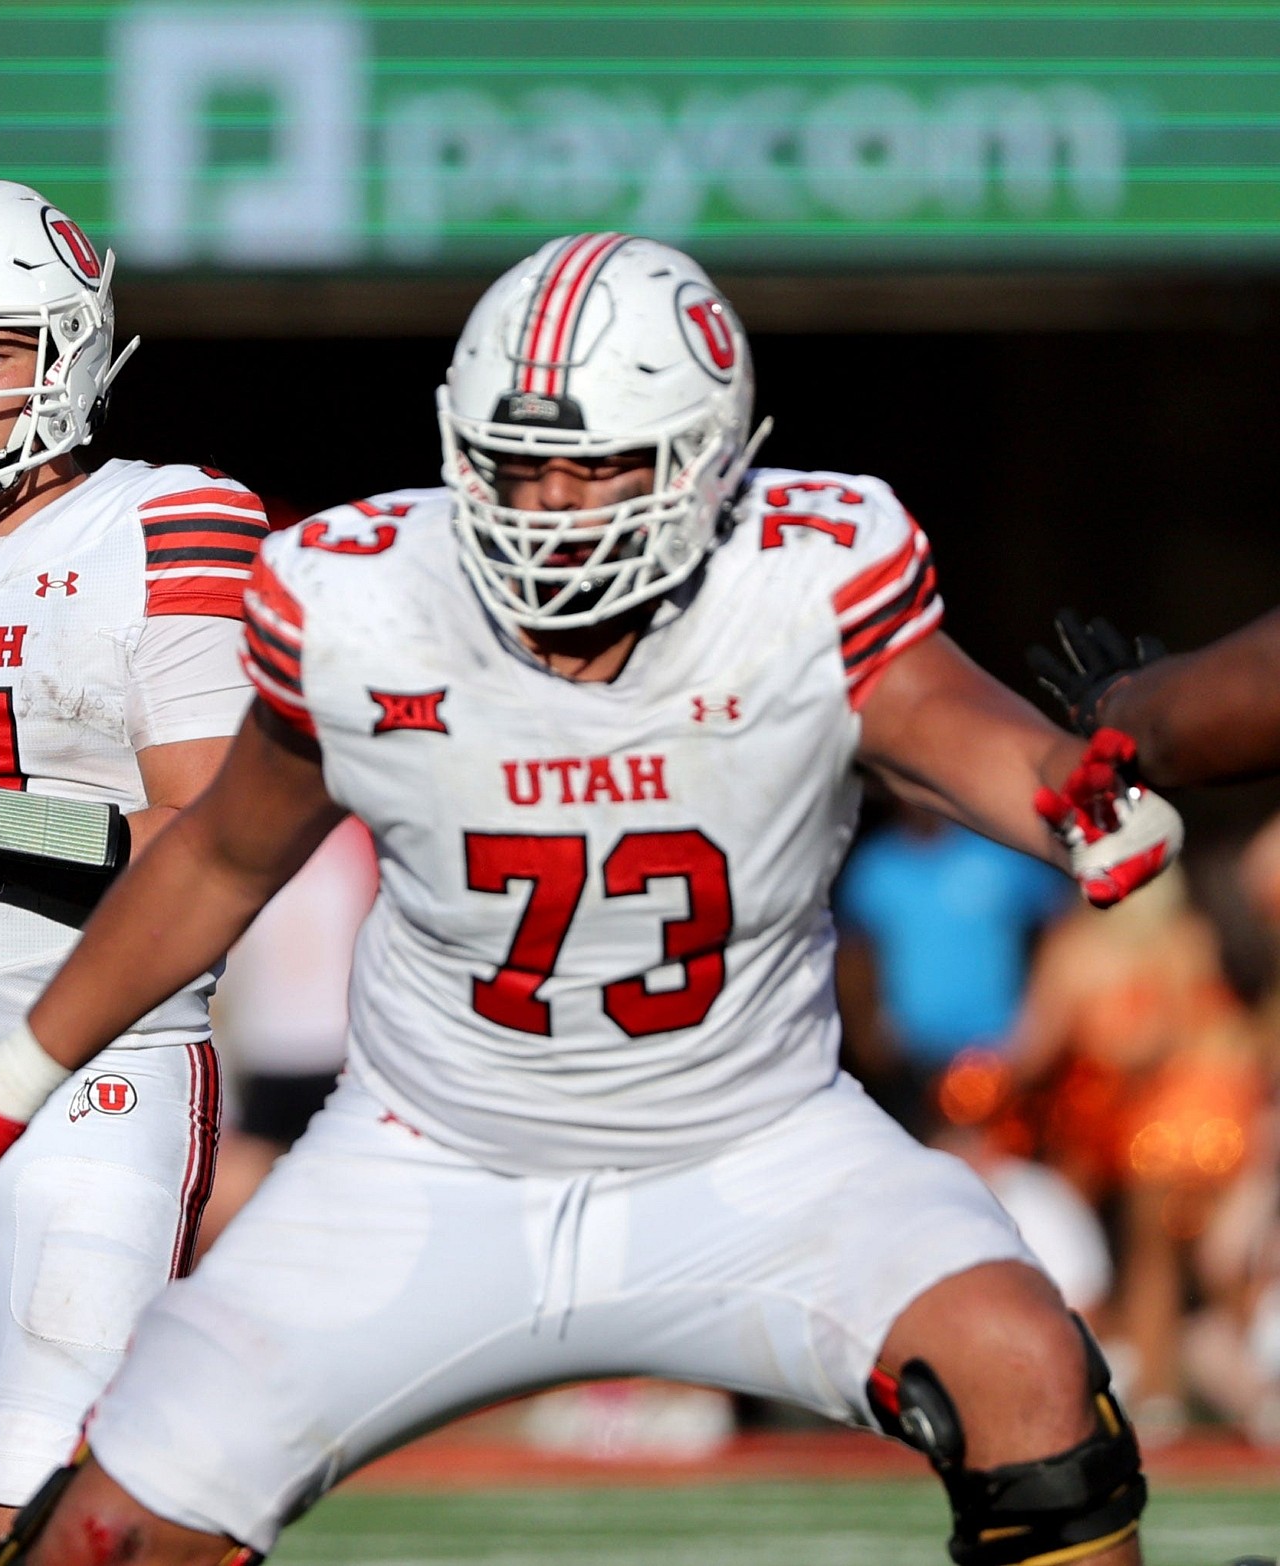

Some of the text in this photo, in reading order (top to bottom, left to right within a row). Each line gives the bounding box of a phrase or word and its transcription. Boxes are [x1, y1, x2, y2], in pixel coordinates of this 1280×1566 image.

[384, 82, 1125, 260] paycom
[53, 221, 100, 278] U
[687, 302, 734, 369] U
[760, 481, 864, 551] 73
[501, 755, 670, 807] UTAH
[464, 829, 734, 1039] 73
[96, 1082, 129, 1112] U
